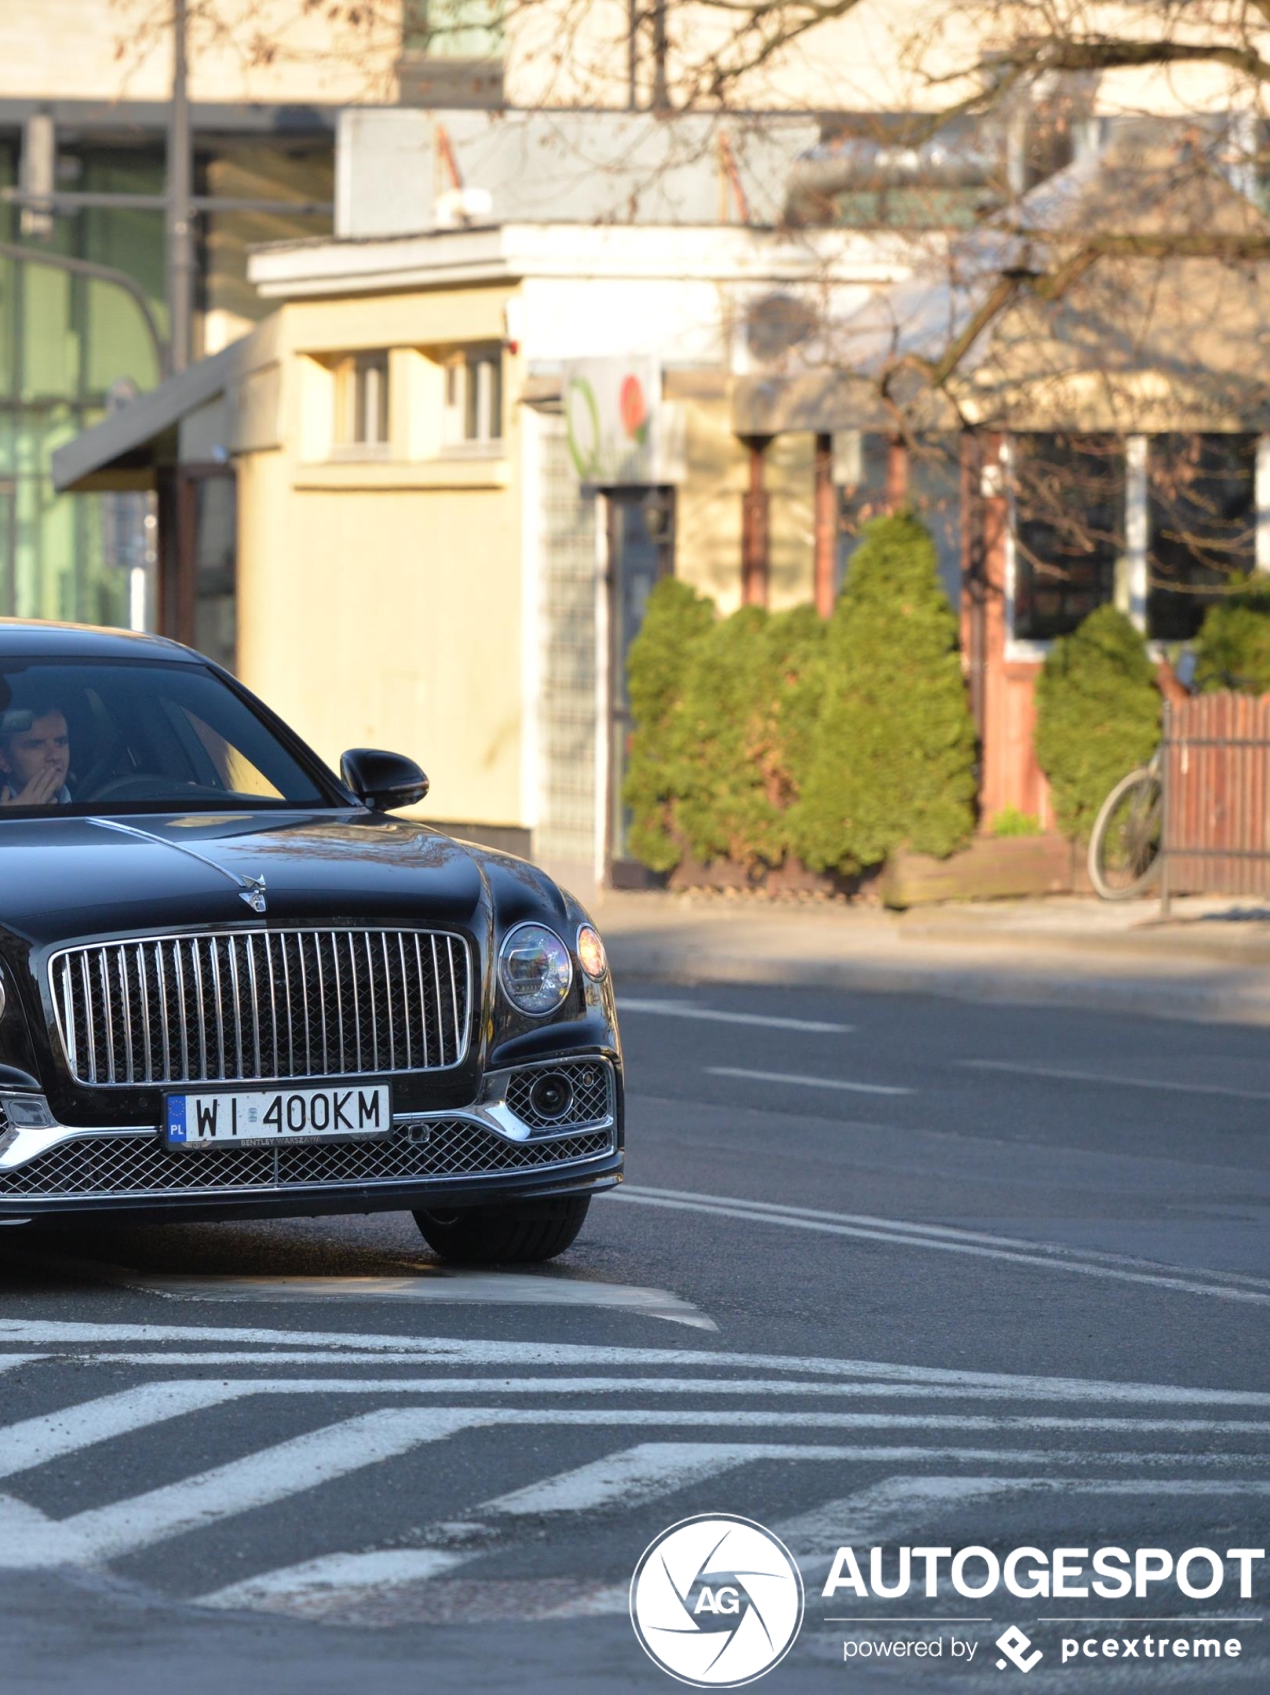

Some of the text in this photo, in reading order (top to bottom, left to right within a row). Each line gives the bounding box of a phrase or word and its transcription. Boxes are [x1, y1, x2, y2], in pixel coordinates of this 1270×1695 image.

[196, 1090, 380, 1137] WI 400KM
[170, 1124, 185, 1135] PL
[240, 1136, 323, 1147] BENTLEY WARSZAWA
